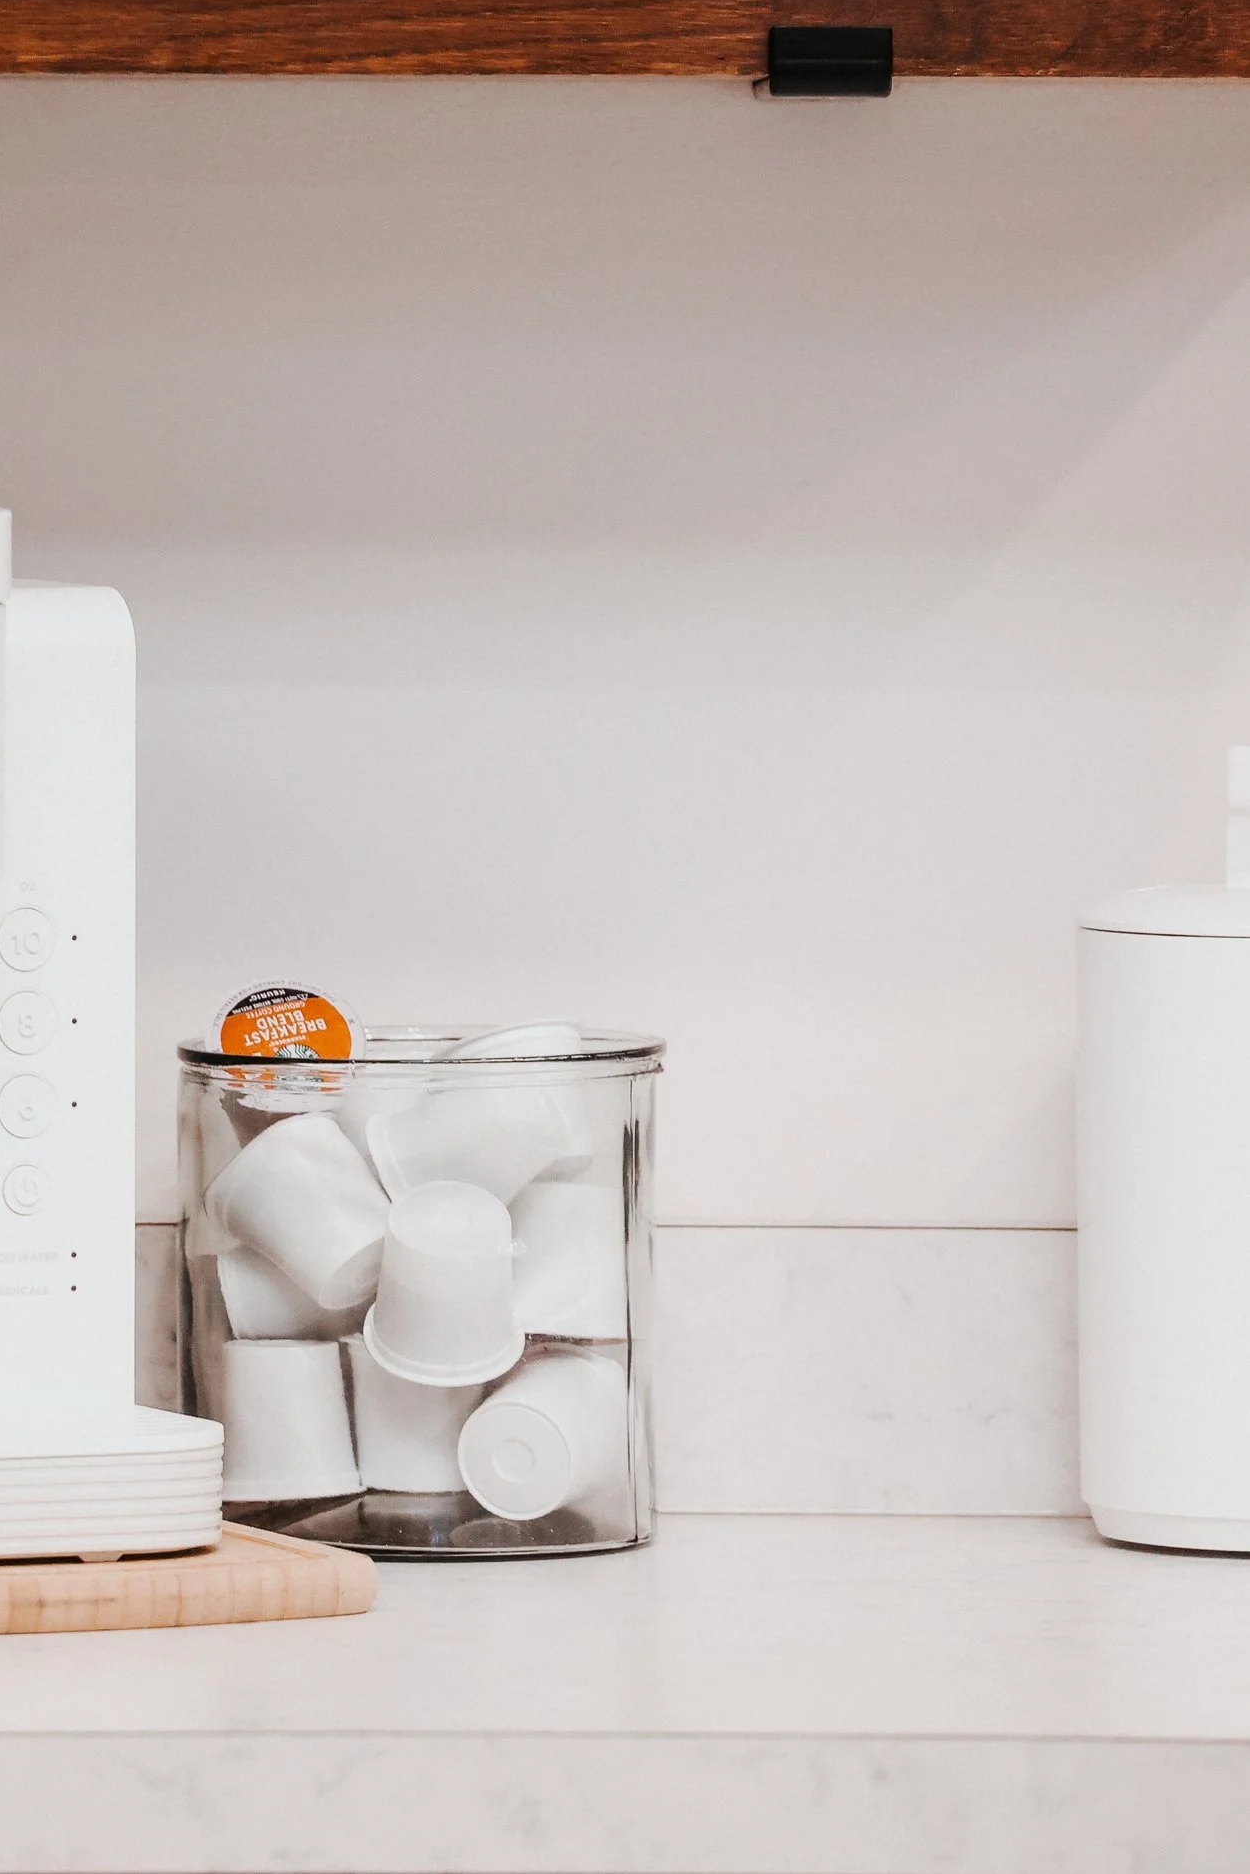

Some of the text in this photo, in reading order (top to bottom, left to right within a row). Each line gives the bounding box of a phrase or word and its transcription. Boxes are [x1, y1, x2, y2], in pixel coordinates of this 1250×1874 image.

[11, 931, 42, 956] 10
[250, 988, 286, 1002] KEURIG
[245, 999, 306, 1020] GROUND COFFEE
[256, 1009, 305, 1031] BLEND
[18, 1013, 38, 1039] 8
[243, 1017, 327, 1047] BREAKFAST
